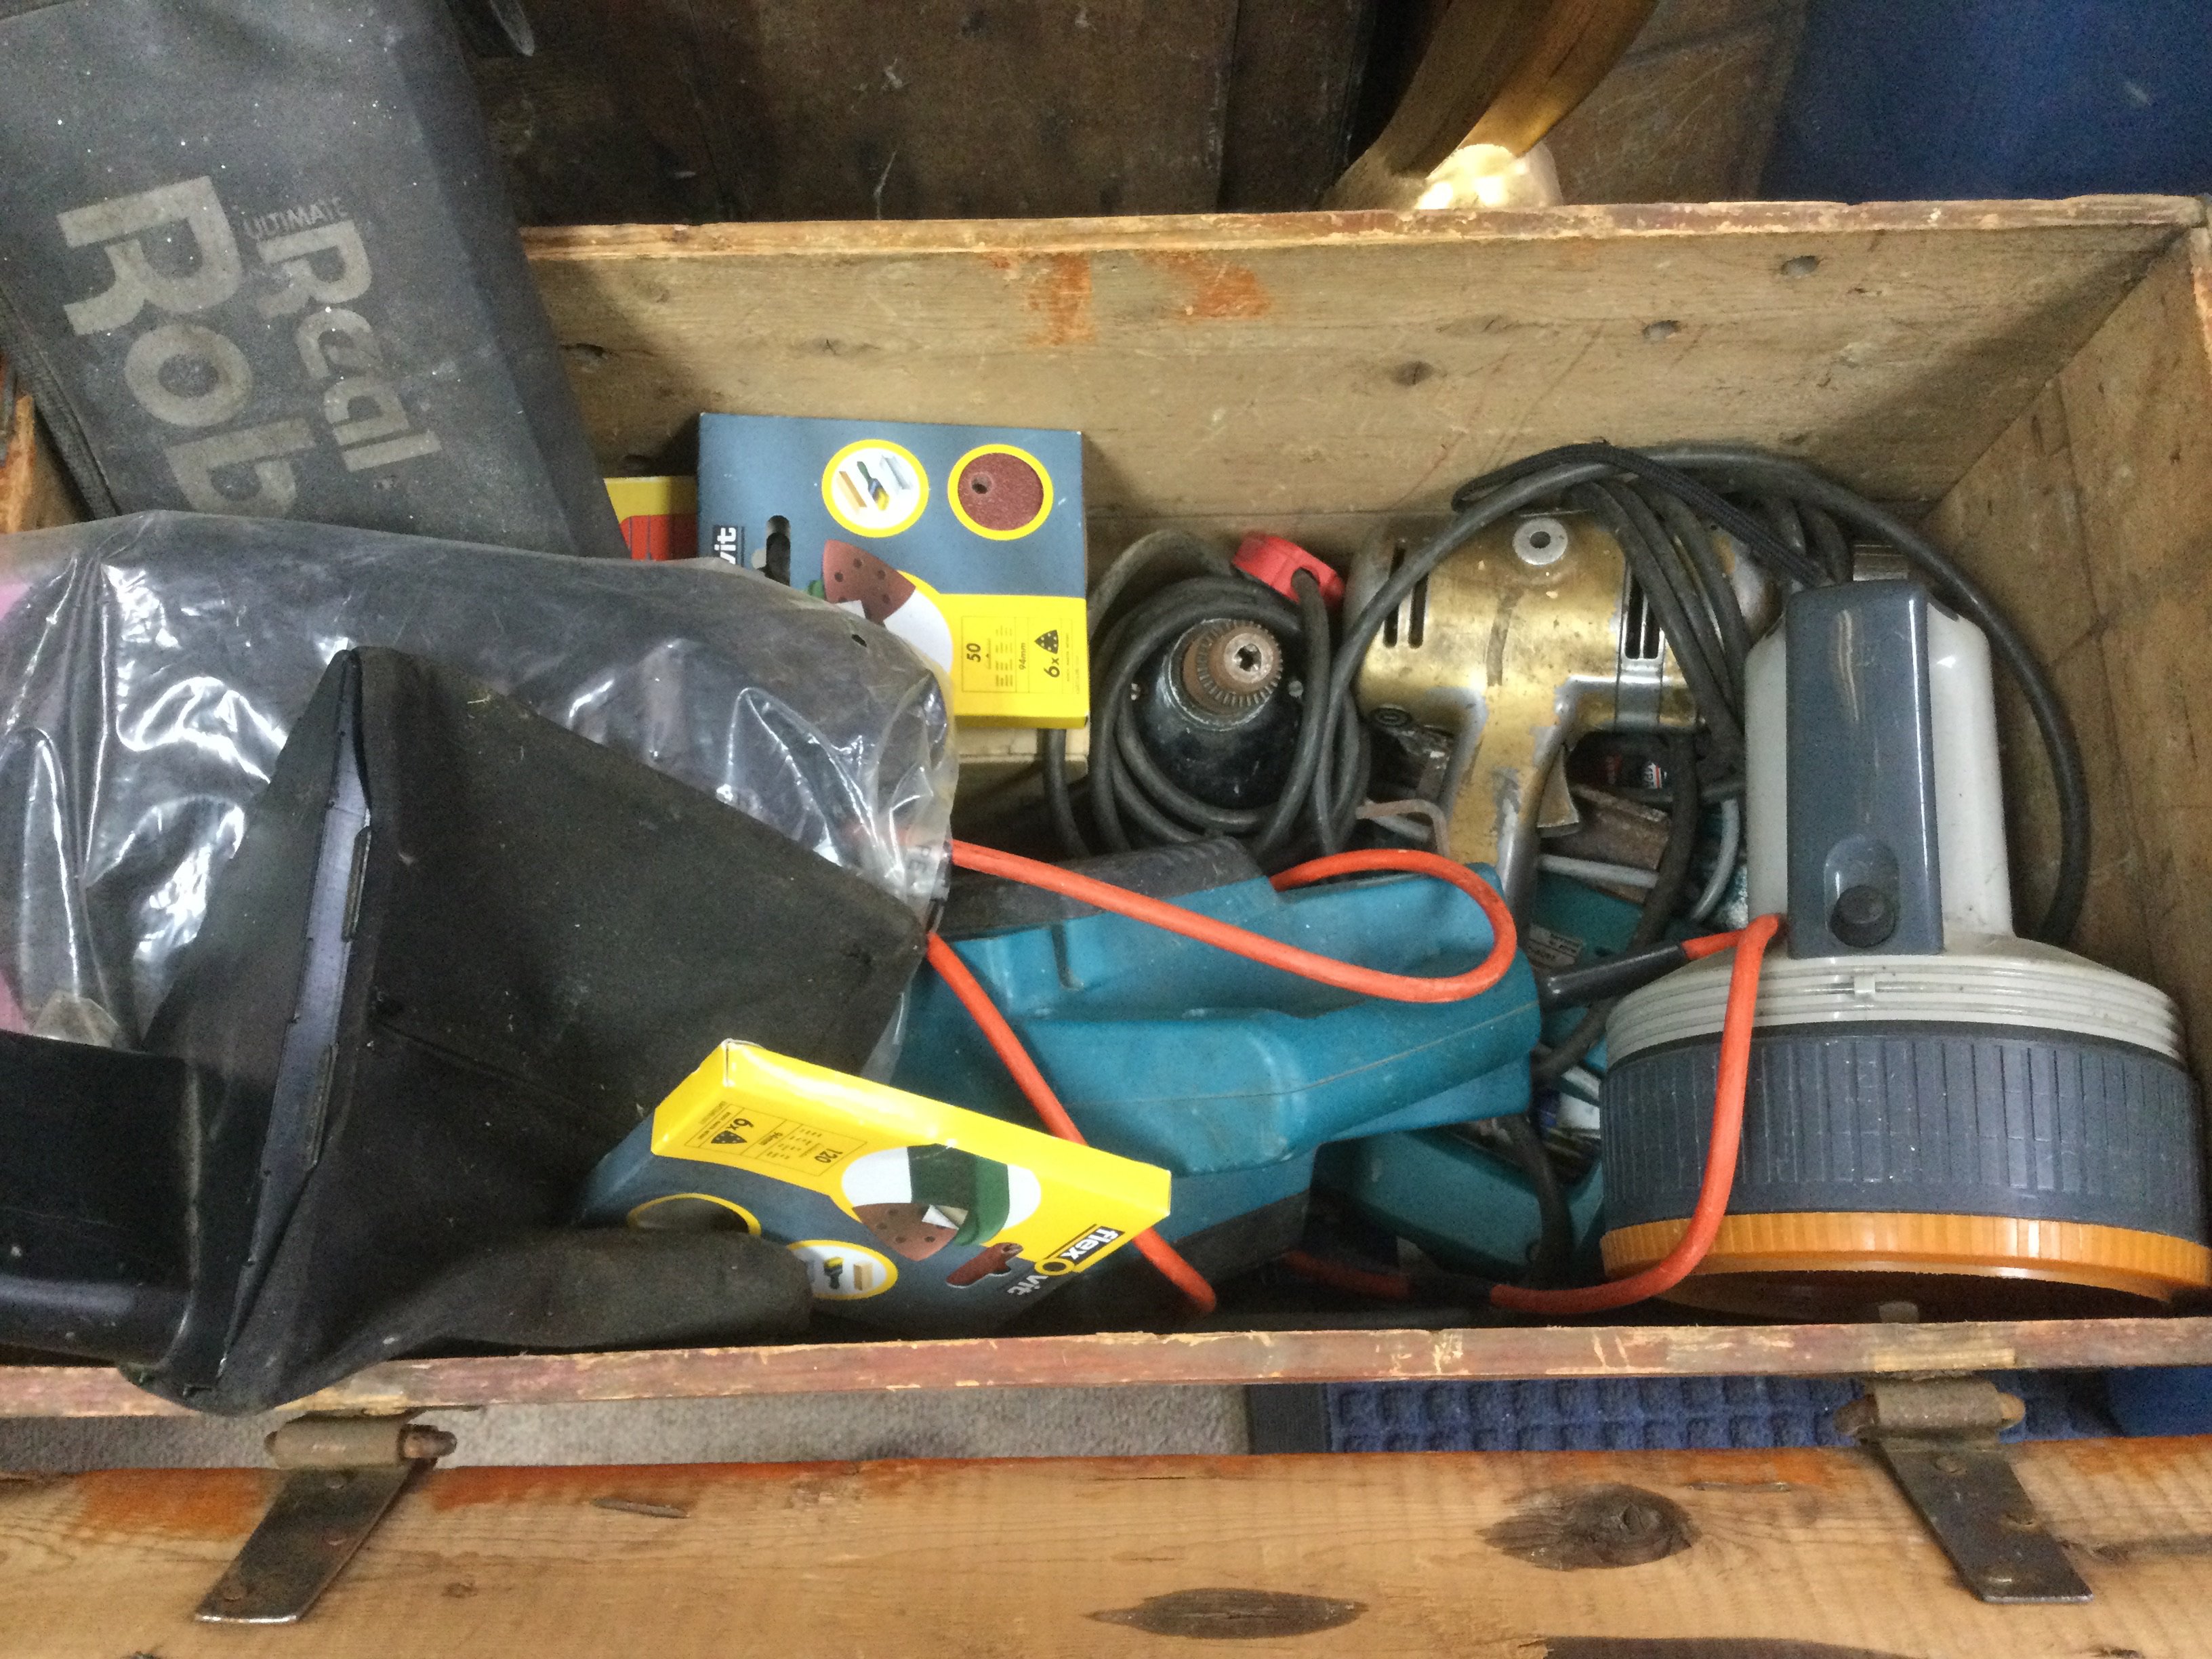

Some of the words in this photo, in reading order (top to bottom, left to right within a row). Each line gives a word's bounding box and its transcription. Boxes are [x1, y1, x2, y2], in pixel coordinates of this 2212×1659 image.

[242, 197, 349, 240] ULTIMATE
[257, 220, 443, 472] Real
[966, 642, 981, 663] 50
[1044, 657, 1060, 678] 6x
[814, 1148, 843, 1164] 120
